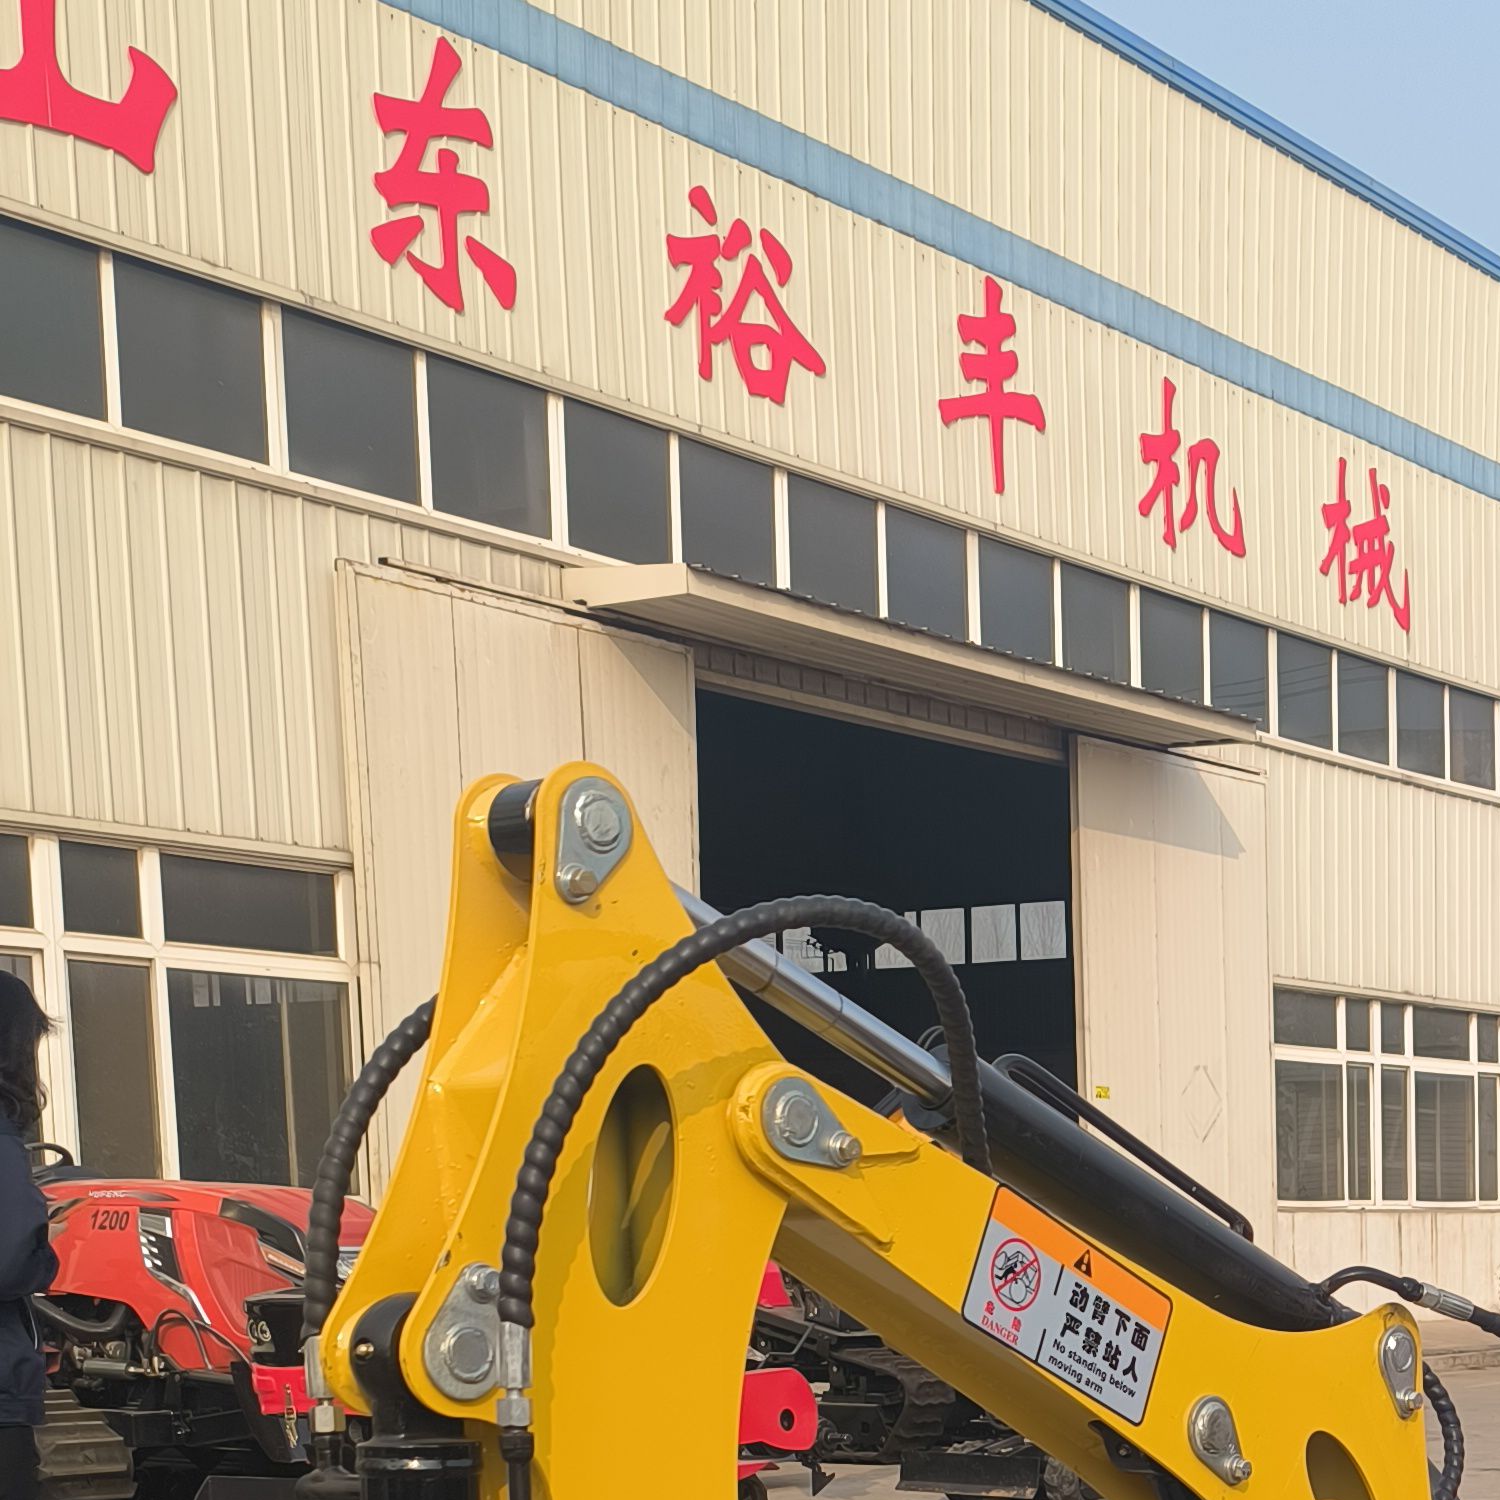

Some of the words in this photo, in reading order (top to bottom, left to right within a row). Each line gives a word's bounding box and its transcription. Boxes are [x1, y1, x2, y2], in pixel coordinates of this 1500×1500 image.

[91, 1209, 130, 1231] 1200
[981, 1314, 1019, 1346] DANGER
[1069, 1281, 1151, 1351] 动臂下面
[1052, 1338, 1066, 1354] No
[1068, 1350, 1107, 1382] standing
[1109, 1374, 1136, 1398] below
[1060, 1312, 1138, 1383] 严禁站人
[1048, 1356, 1083, 1384] moving
[1085, 1378, 1103, 1394] arm
